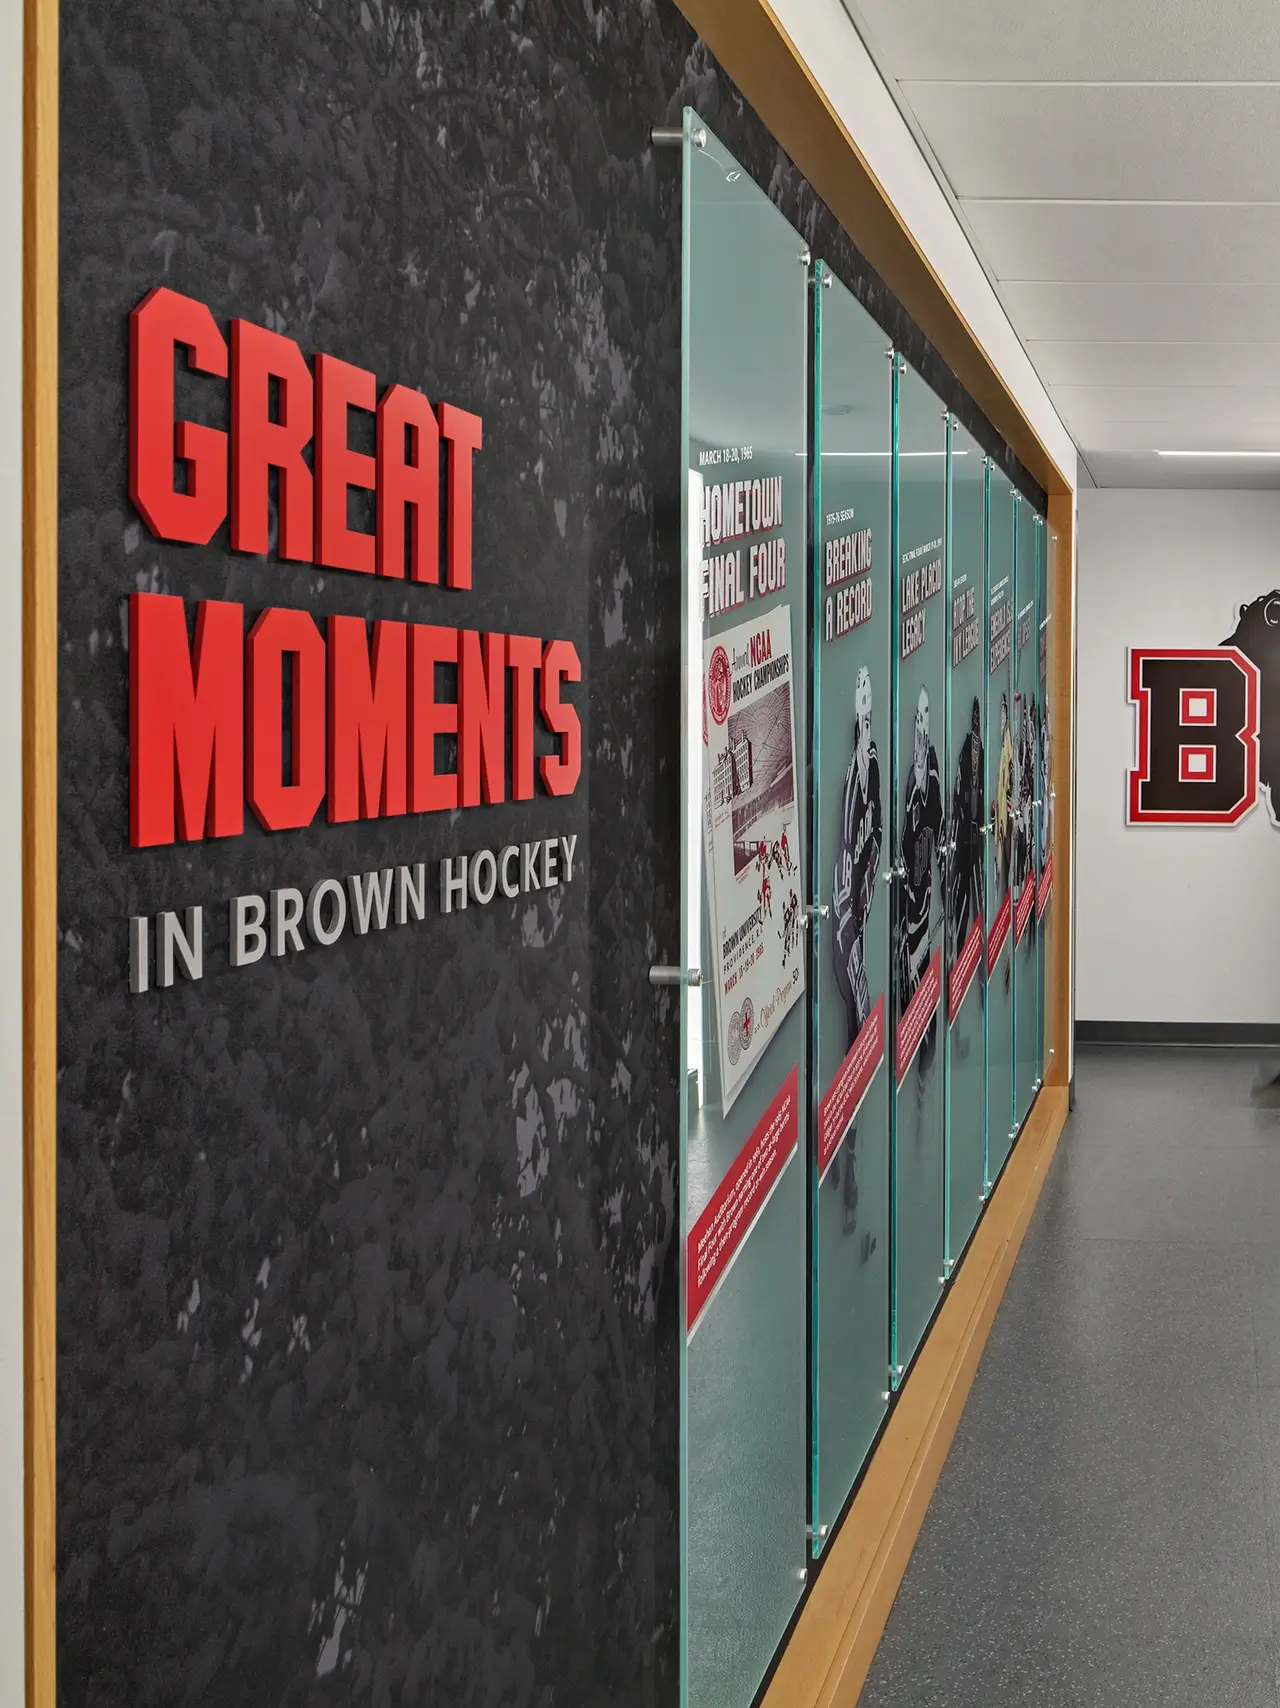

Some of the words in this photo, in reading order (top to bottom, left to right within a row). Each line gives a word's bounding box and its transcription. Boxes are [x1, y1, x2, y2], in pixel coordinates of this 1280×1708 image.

[129, 286, 482, 590] GREAT
[699, 449, 721, 466] MARCH
[723, 447, 740, 464] 18-20,
[741, 445, 753, 460] 1965
[700, 475, 783, 546] HOMETOWN
[699, 550, 744, 618] FINAL
[750, 538, 787, 598] FOUR
[825, 528, 872, 588] BREAKING
[825, 596, 833, 642] A
[836, 577, 872, 638] RECORD
[902, 570, 919, 615] LAKE
[750, 629, 772, 667] NCAA
[902, 607, 926, 659] LEGACY
[732, 673, 753, 703] HOCKEY
[754, 654, 790, 690] CHAMPIONSHIPS
[129, 592, 582, 847] MOMENTS
[1126, 646, 1260, 825] B
[129, 905, 203, 993] IN
[229, 862, 425, 966] BROWN
[440, 834, 578, 914] HOCKEY
[722, 929, 740, 959] BROWN
